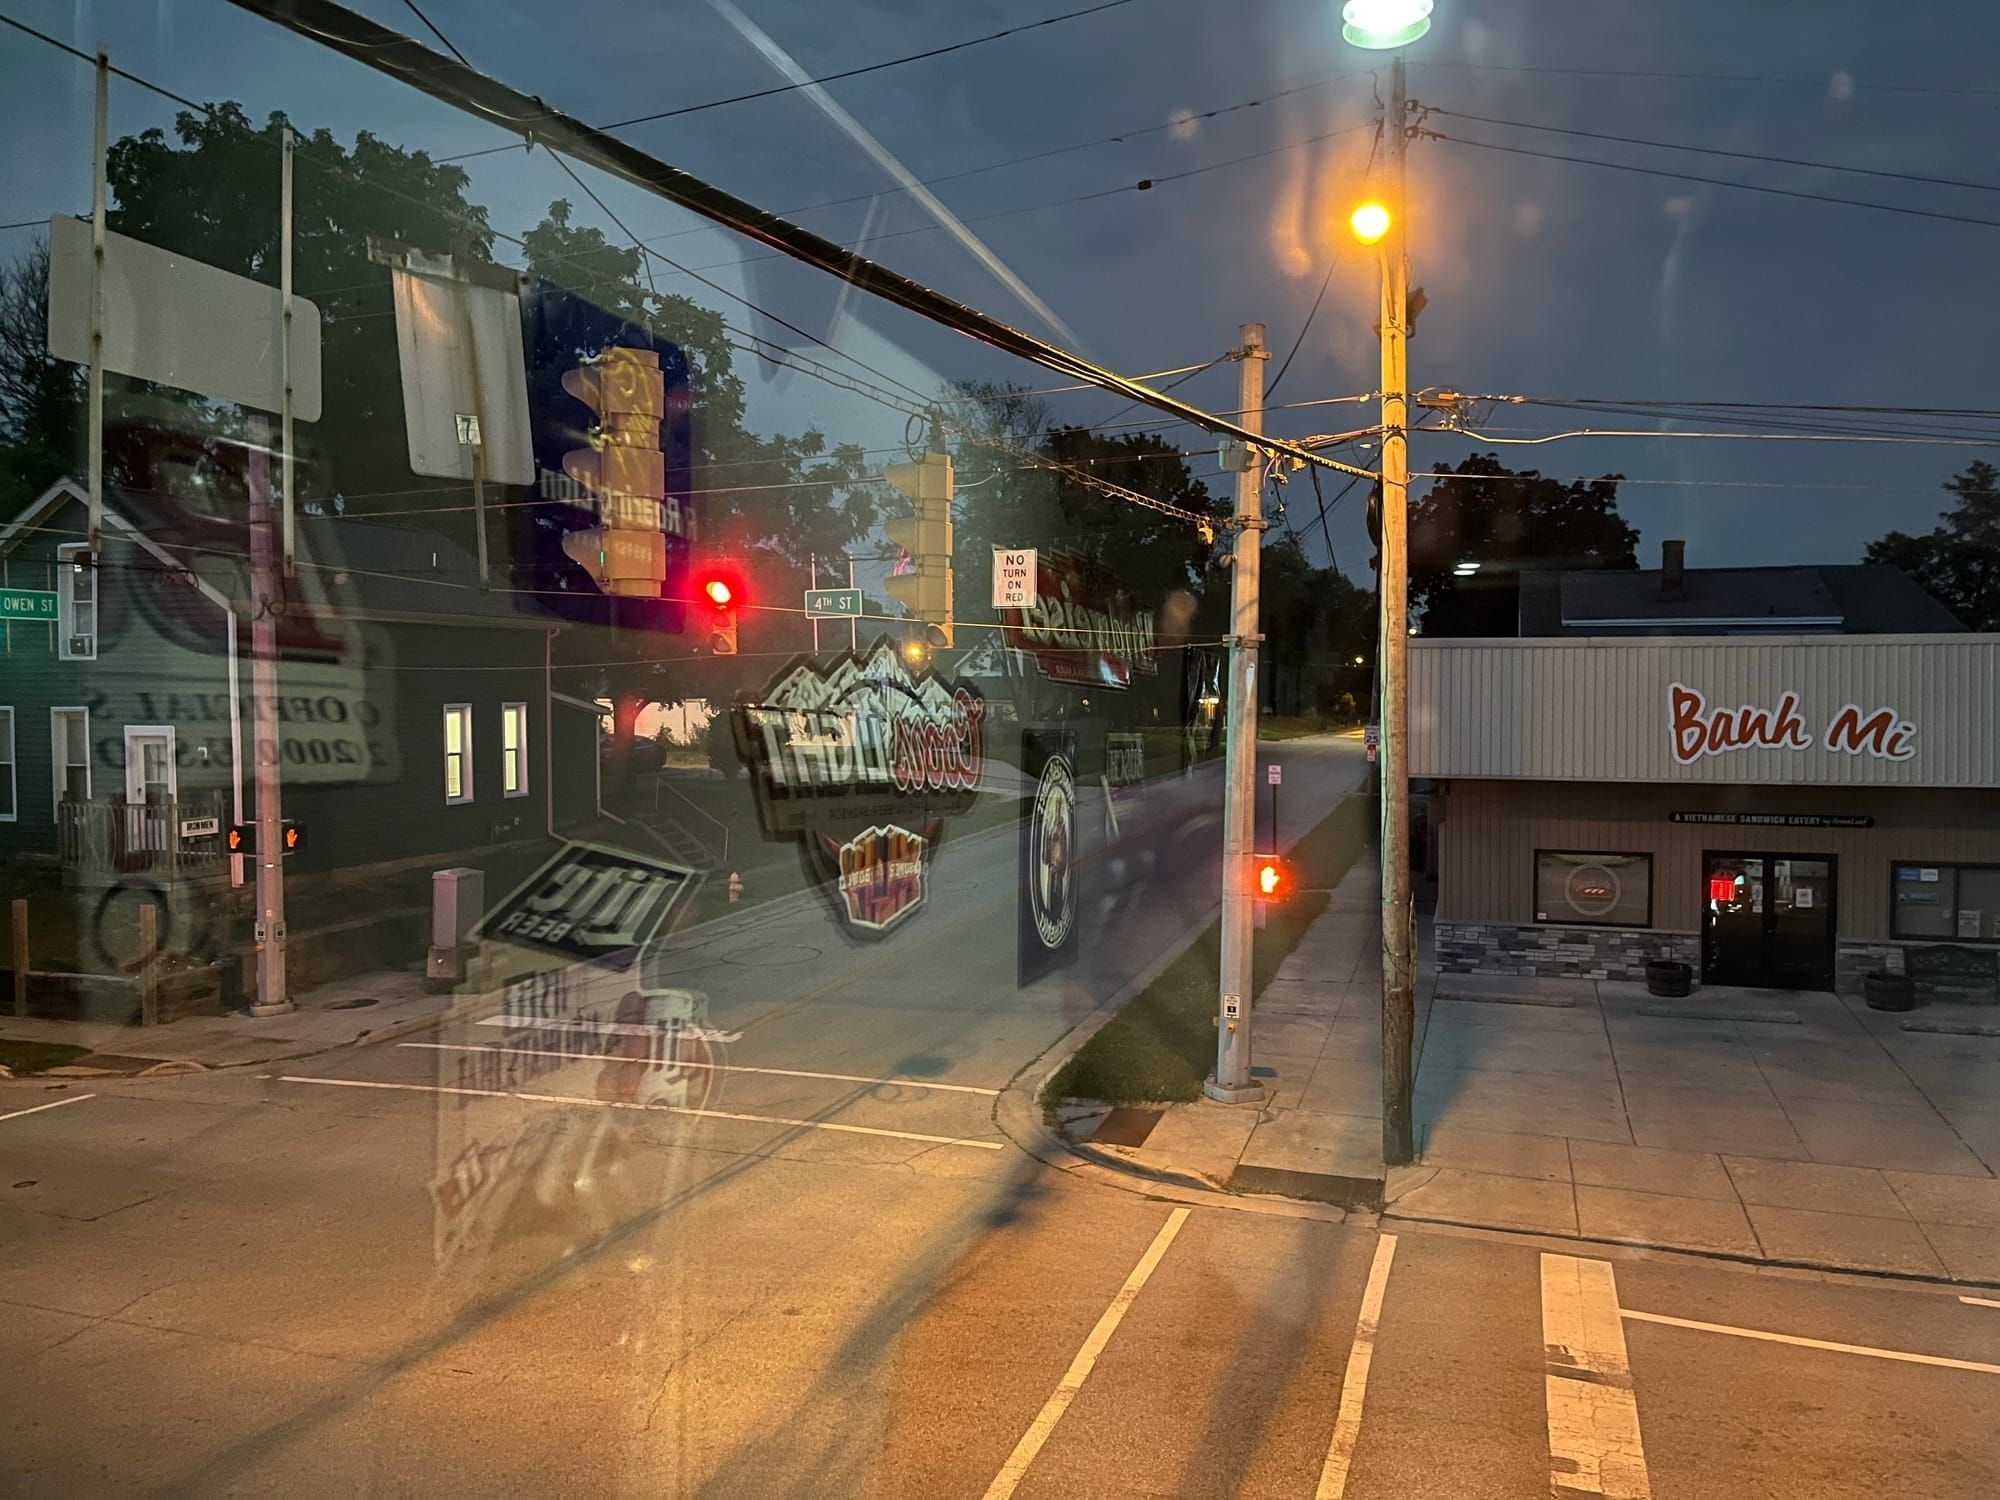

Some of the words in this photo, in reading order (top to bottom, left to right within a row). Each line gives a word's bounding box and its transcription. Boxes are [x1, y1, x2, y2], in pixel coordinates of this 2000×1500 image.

[461, 416, 471, 441] 7
[1005, 554, 1025, 566] NO
[1002, 568, 1027, 578] TURN
[1007, 580, 1022, 590] ON
[814, 596, 833, 610] 4TH
[839, 596, 853, 610] ST
[1005, 592, 1024, 602] RED
[3, 597, 35, 612] OWEN
[40, 598, 53, 613] ST
[1671, 685, 1810, 761] Banh
[1826, 707, 1913, 758] Mi
[1674, 813, 1681, 821] A
[1684, 813, 1736, 823] VIETNAMESE
[1740, 815, 1785, 824] SANDWICH
[1788, 816, 1820, 825] EATERY
